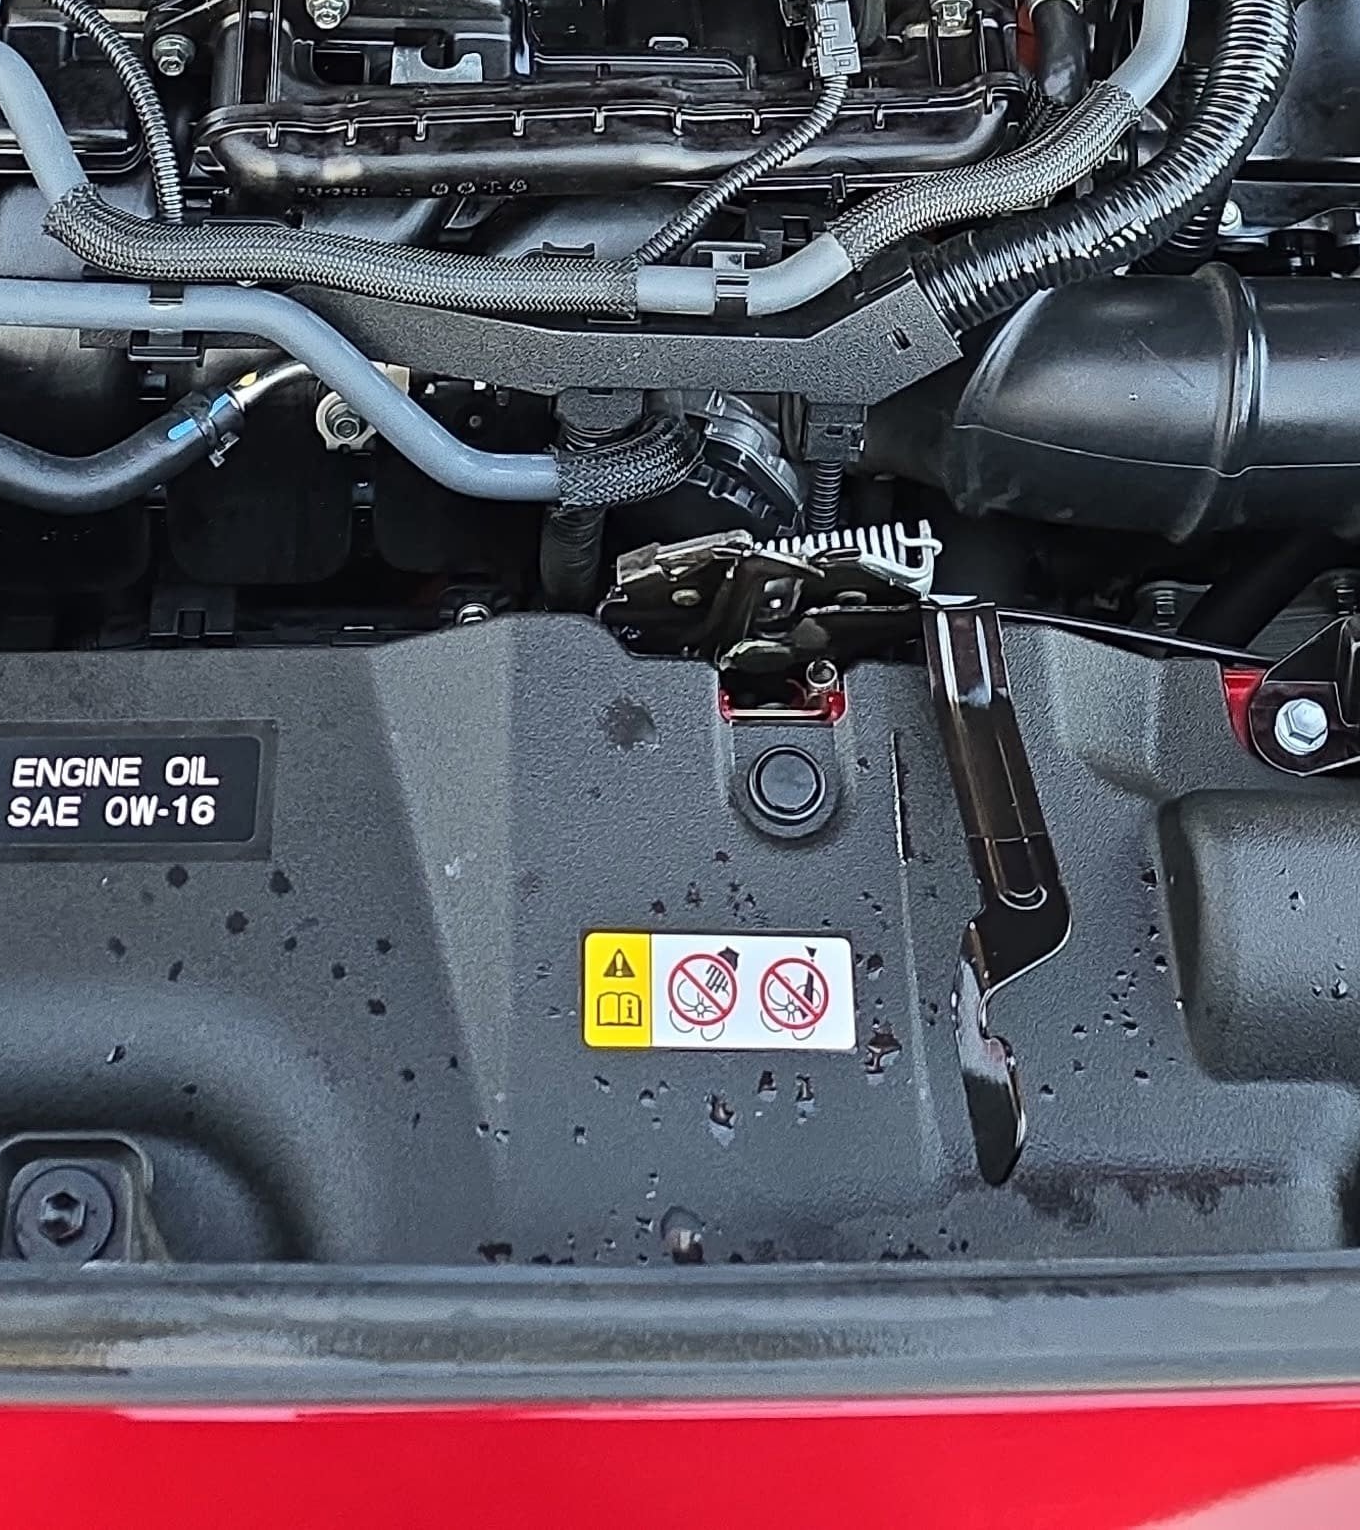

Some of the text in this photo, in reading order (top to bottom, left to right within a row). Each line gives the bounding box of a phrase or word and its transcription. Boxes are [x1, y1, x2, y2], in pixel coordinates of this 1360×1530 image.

[12, 756, 220, 788] ENGINE OIL
[7, 794, 216, 827] SAE 0W-16
